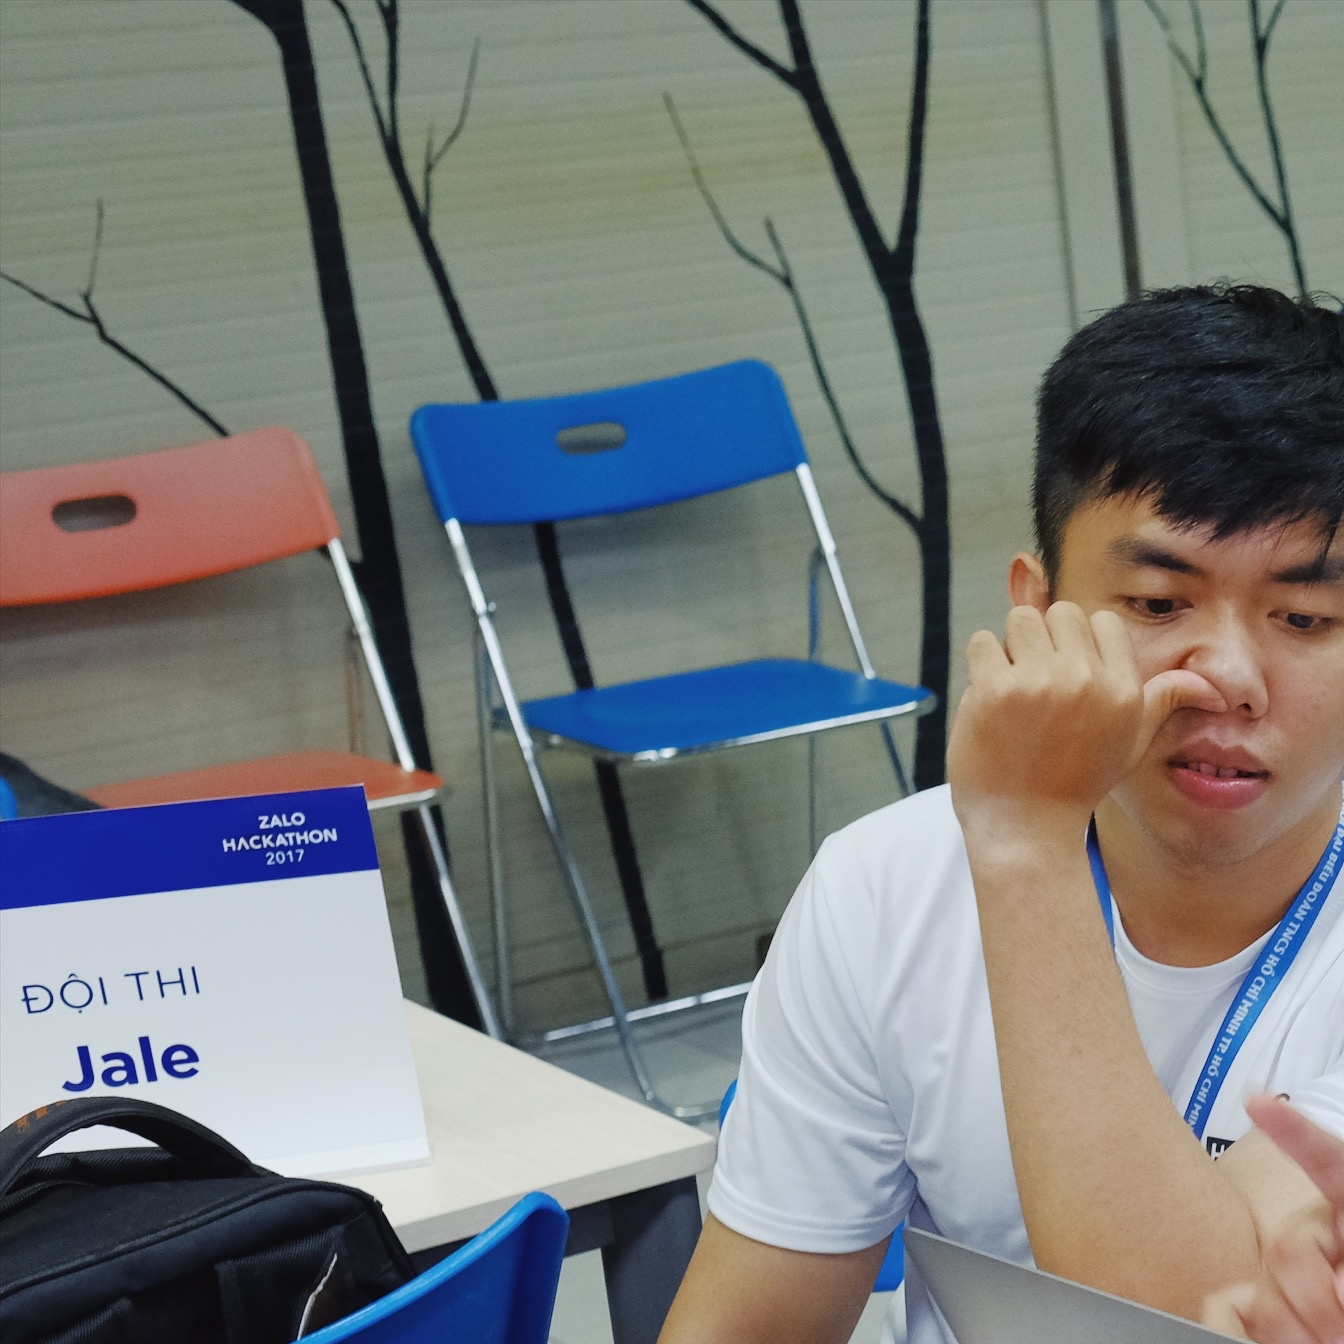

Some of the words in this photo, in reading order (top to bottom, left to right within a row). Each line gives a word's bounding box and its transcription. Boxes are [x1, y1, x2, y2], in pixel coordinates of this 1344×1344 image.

[258, 811, 306, 830] ZALO
[222, 828, 338, 854] HACKATHON
[265, 848, 305, 866] 2017
[1273, 921, 1301, 956] TNCS
[21, 972, 108, 1014] ĐỘI
[124, 966, 201, 1003] THI
[1226, 999, 1254, 1037] MINH
[62, 1035, 200, 1092] Jale
[1187, 1103, 1203, 1132] MIN
